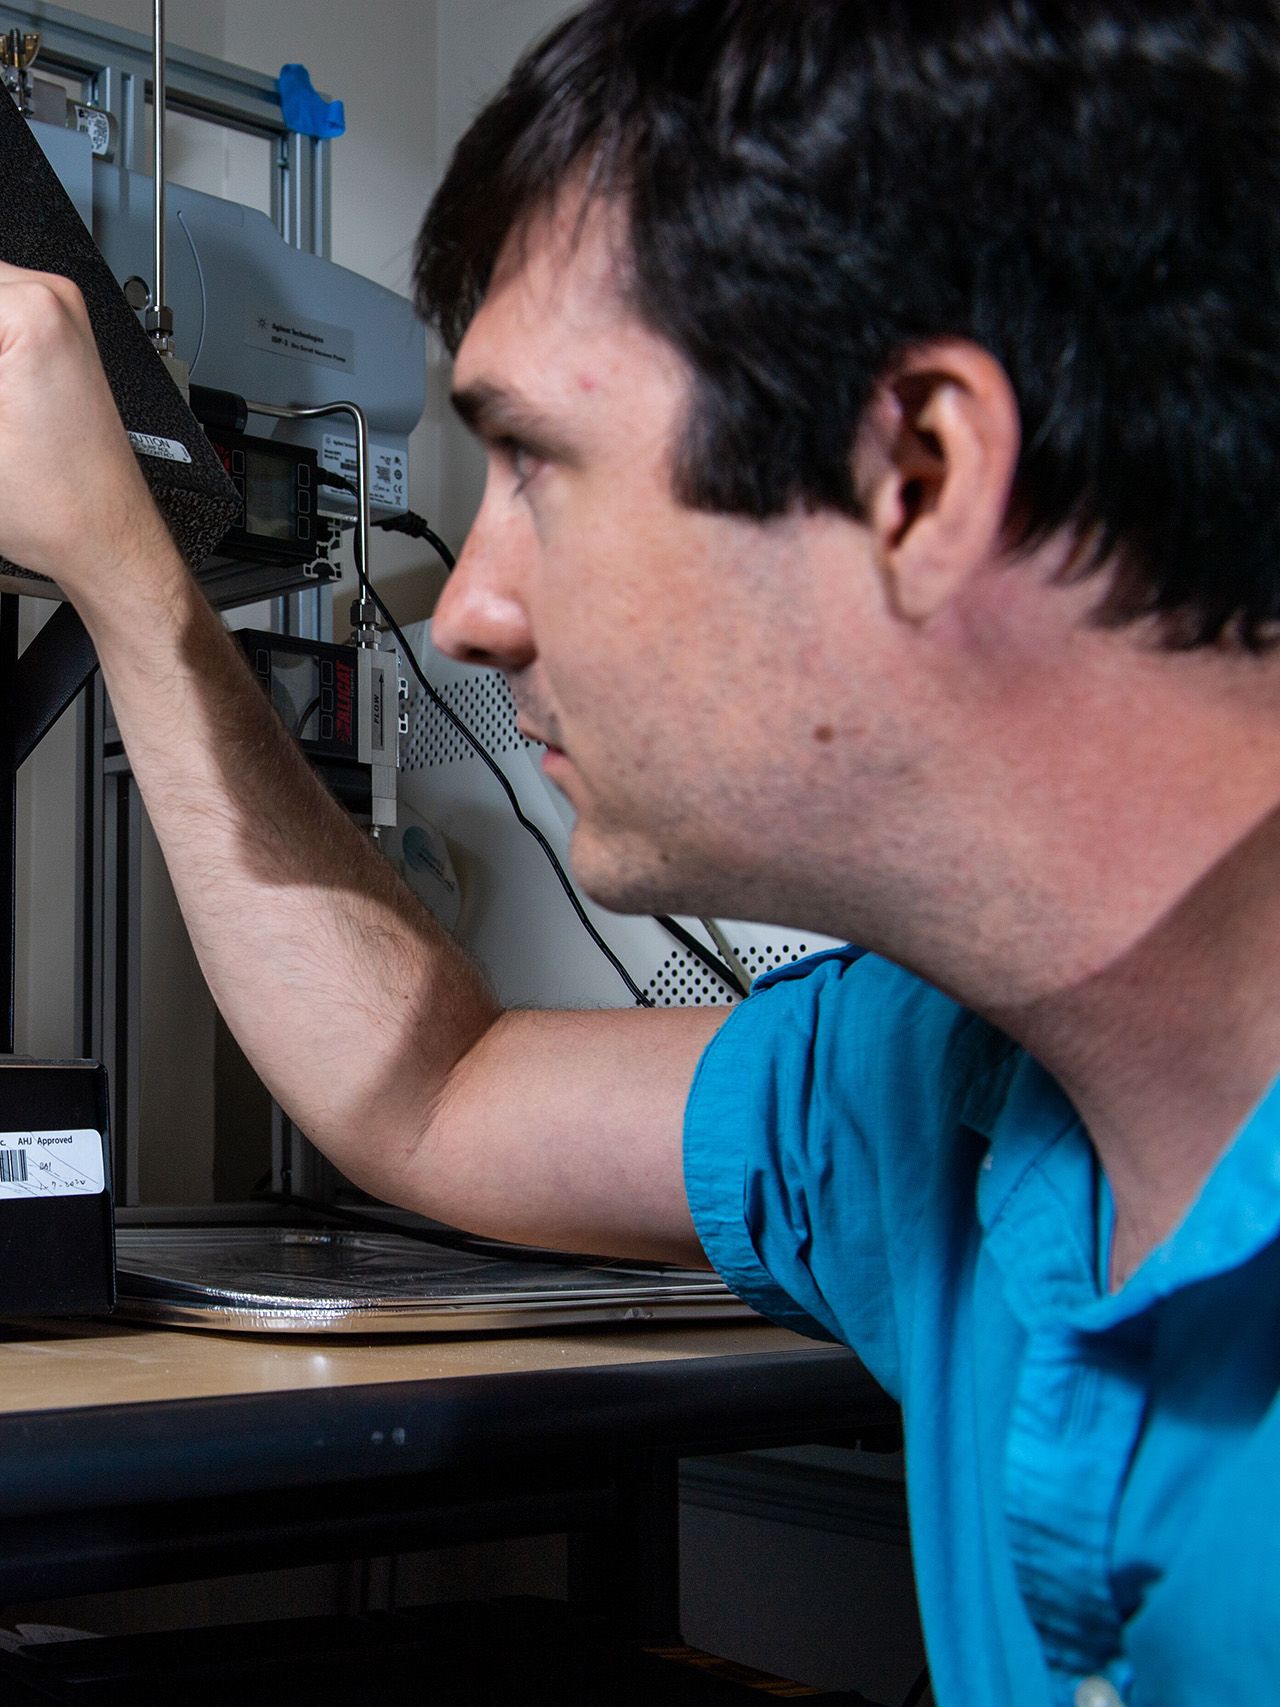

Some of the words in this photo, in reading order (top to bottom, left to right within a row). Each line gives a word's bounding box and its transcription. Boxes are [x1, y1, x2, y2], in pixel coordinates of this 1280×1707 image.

[128, 433, 170, 448] AUTION
[17, 1137, 32, 1146] AHJ
[37, 1135, 73, 1146] Approved
